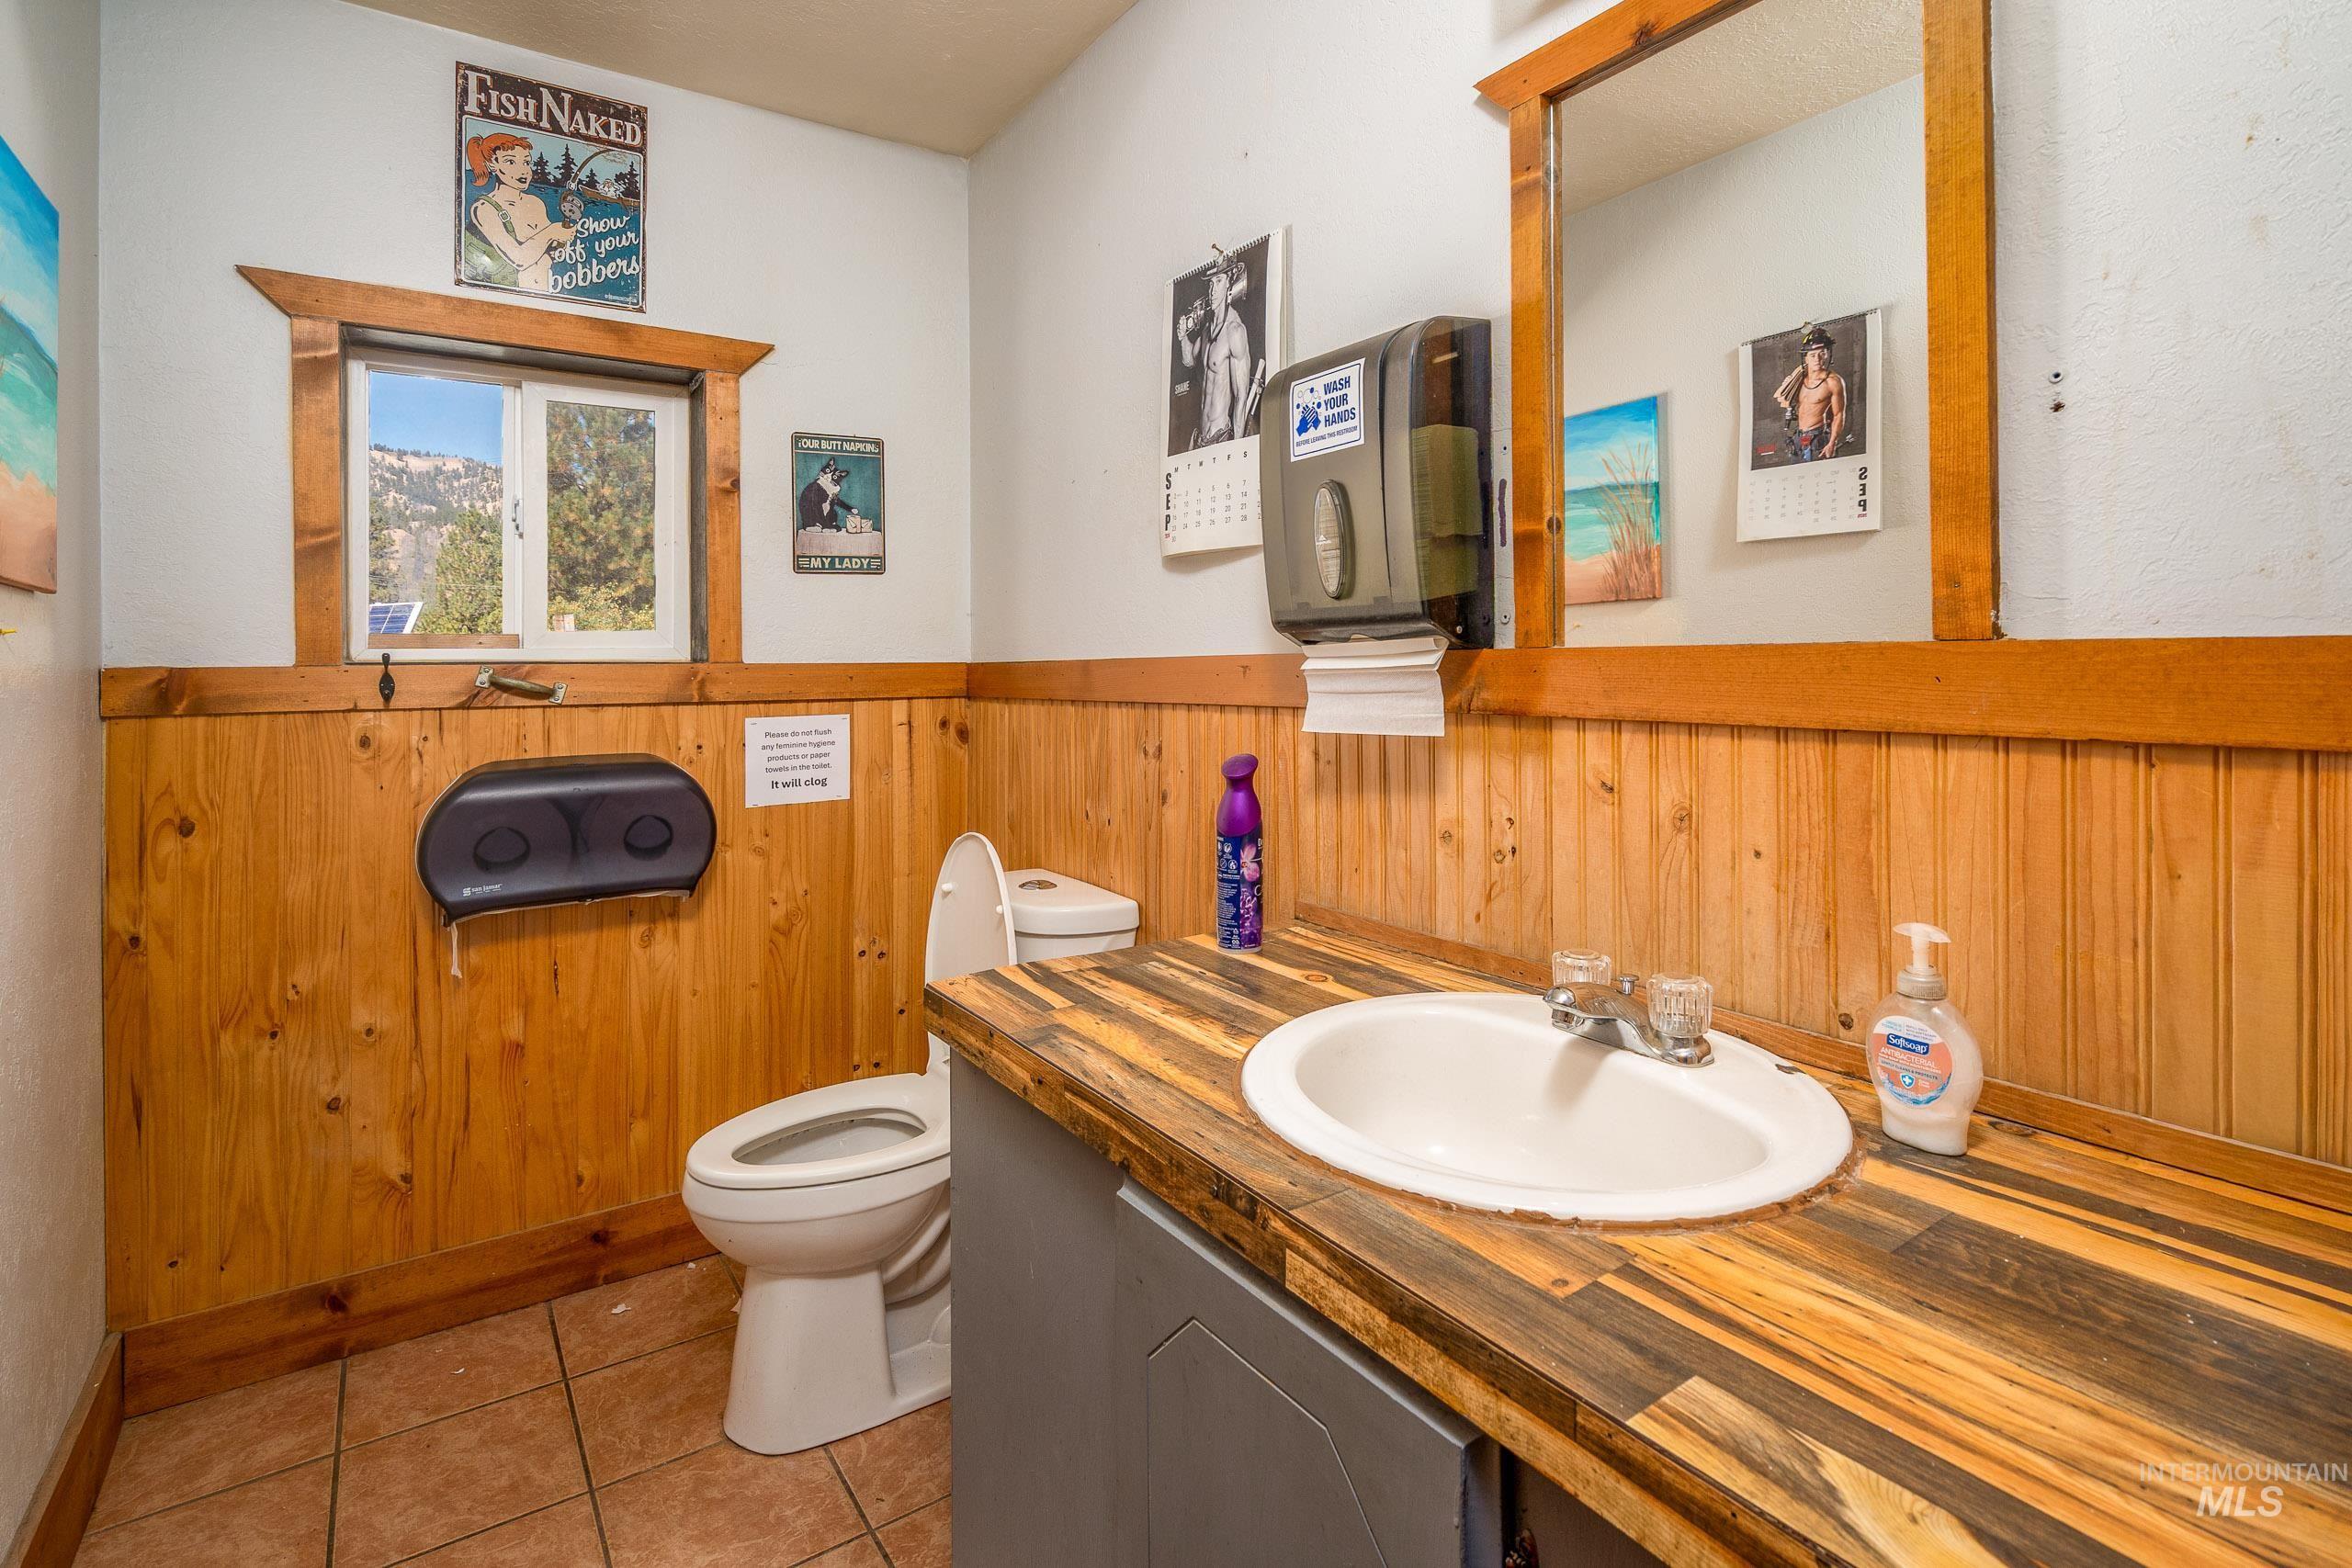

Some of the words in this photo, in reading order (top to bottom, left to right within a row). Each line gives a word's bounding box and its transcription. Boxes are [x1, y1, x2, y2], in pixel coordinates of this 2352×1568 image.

[576, 216, 630, 238] Show
[552, 240, 588, 263] off
[594, 231, 639, 258] your
[548, 256, 640, 294] bobbers
[1323, 375, 1351, 396] WASH
[1324, 393, 1349, 412] YOUR
[1324, 407, 1356, 428] HANDS
[1295, 438, 1310, 447] BEFORE
[1310, 434, 1327, 444] LEAVING
[1327, 431, 1336, 439] THIS
[1336, 425, 1358, 436] RESTROOM
[820, 440, 842, 450] BUTT
[842, 441, 879, 453] NAPKINS
[810, 558, 831, 569] MY
[834, 558, 870, 569] LADY
[808, 740, 836, 749] hygiene
[767, 754, 800, 762] products
[809, 751, 831, 760] paper
[765, 765, 790, 773] towels
[771, 780, 779, 789] It
[781, 778, 802, 788] will
[804, 777, 828, 786] clog
[1888, 1034, 1928, 1054] Softsoap
[1881, 1047, 1935, 1066] ANTIBACTERIAL
